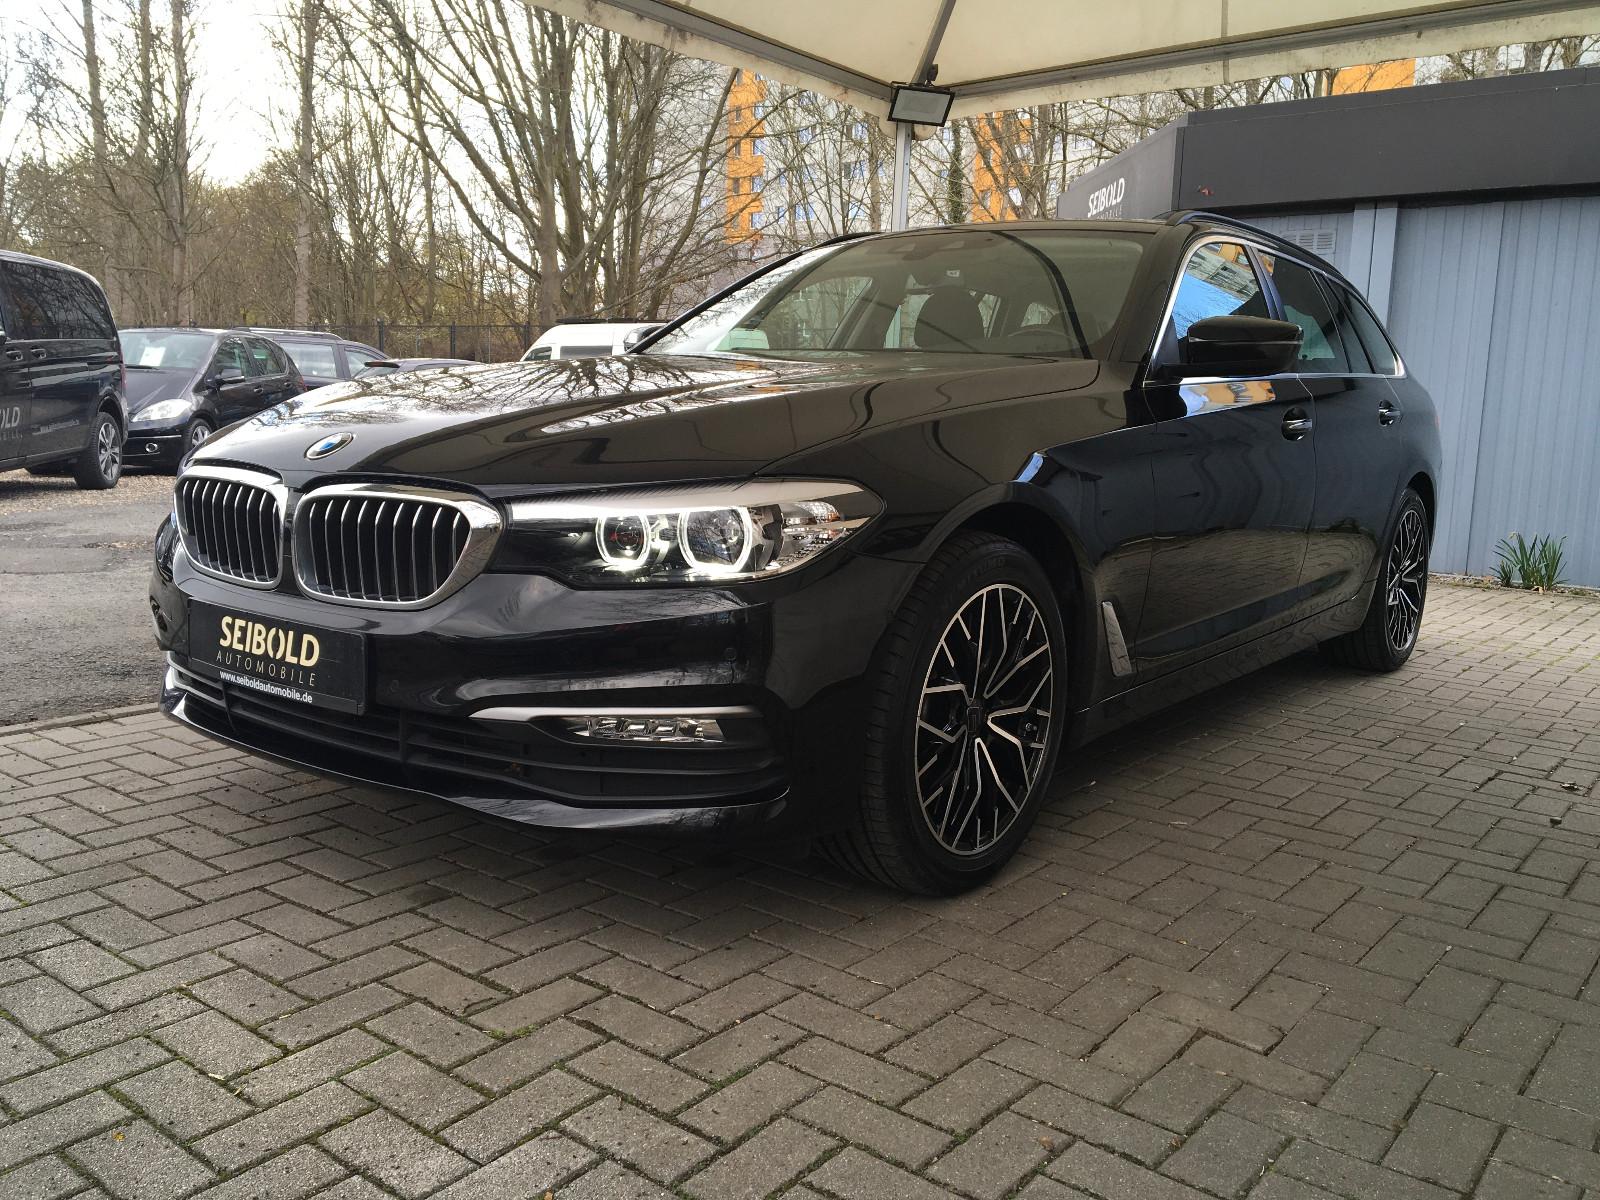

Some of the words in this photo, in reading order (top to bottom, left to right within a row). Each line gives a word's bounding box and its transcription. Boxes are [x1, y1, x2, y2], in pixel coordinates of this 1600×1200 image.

[1088, 177, 1125, 218] SEIBOLD
[219, 615, 320, 667] SEIBOLD
[216, 650, 316, 687] AUTOMOBILE
[219, 671, 313, 703] www.seiboldautomobile.de
